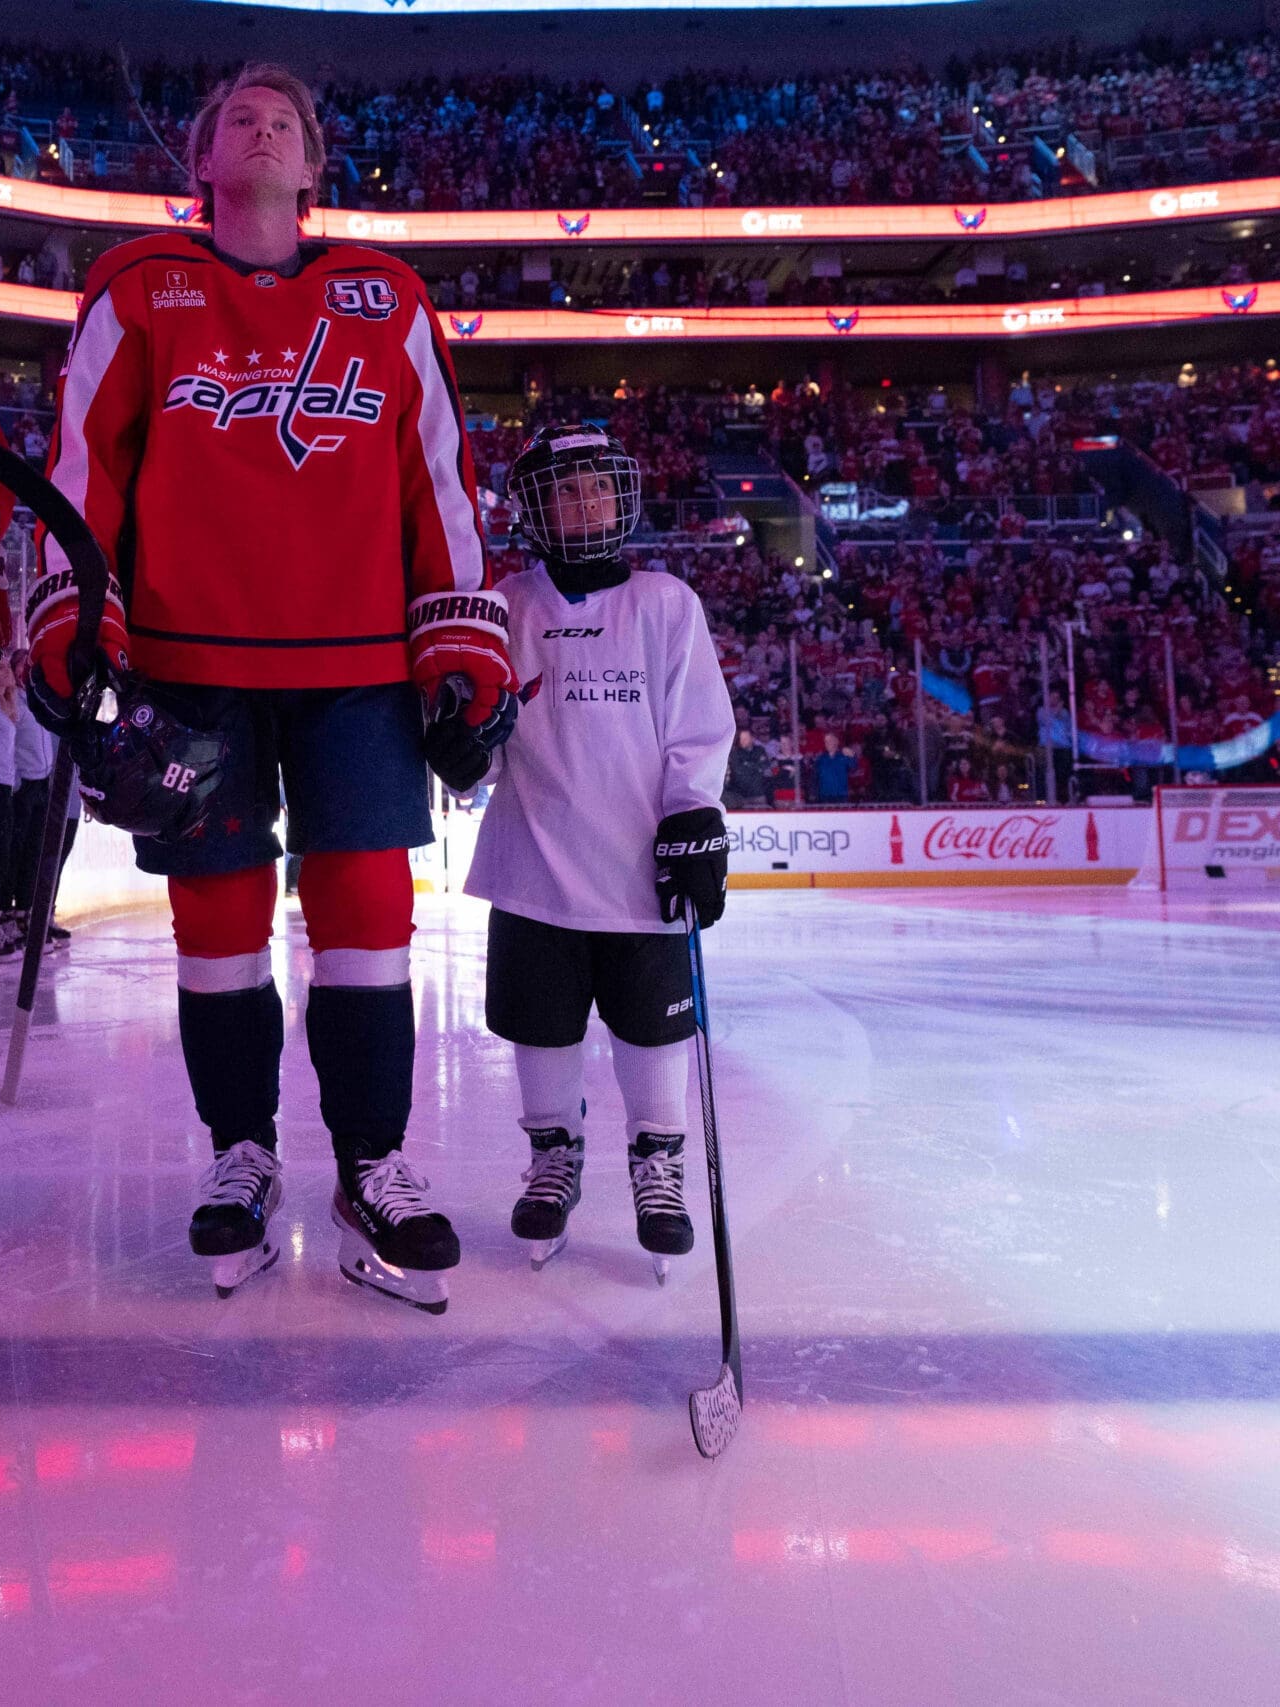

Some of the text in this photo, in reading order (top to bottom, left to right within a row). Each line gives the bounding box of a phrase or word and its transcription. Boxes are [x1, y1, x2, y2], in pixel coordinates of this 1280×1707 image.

[1179, 190, 1219, 209] RTX
[373, 219, 408, 235] RTX
[768, 214, 804, 230] RTX
[152, 289, 205, 300] CAESARS
[333, 279, 393, 311] 50
[152, 298, 207, 309] SPORTSBOOK
[651, 316, 685, 331] RTX
[1028, 307, 1065, 325] RTX
[197, 362, 295, 383] WASHINGTON
[407, 596, 509, 631] WARRIO
[542, 627, 604, 639] CCM
[564, 669, 646, 684] ALL CAPS
[564, 688, 641, 703] ALL HER
[727, 825, 850, 857] ekSynap
[924, 815, 1063, 861] Coca-Cola
[352, 1200, 379, 1235] CCM
